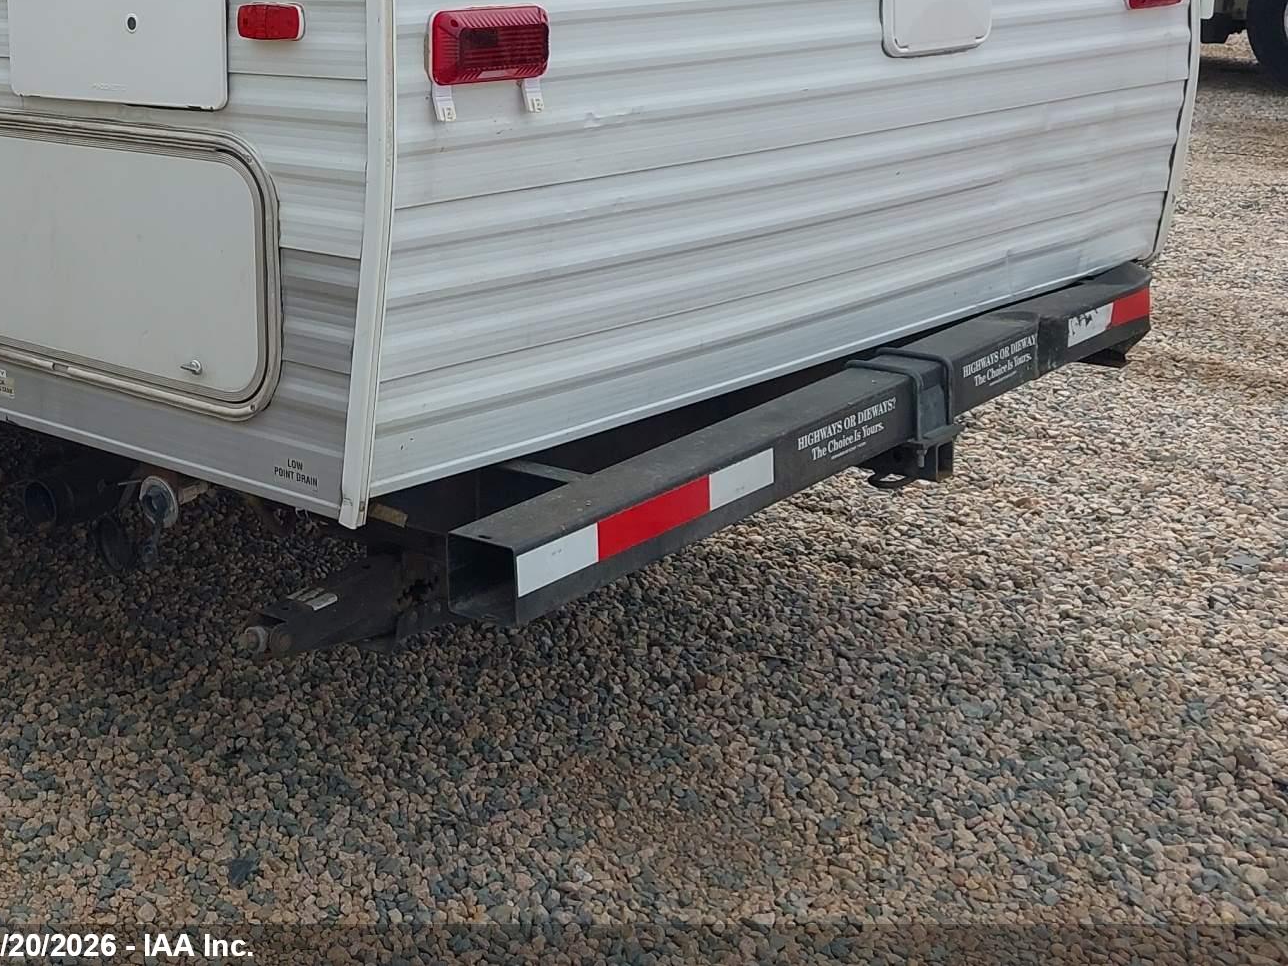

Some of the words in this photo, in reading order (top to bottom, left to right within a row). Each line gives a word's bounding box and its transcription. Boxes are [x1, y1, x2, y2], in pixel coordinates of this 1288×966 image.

[962, 351, 999, 378] HIGHWAYS
[999, 346, 1010, 360] OR
[974, 375, 987, 387] The
[986, 364, 1008, 381] Choice
[1007, 359, 1014, 371] Is
[797, 420, 843, 451] HIGHWAYS
[843, 414, 857, 430] OR
[857, 396, 897, 424] DIEWAYS?
[811, 446, 827, 461] The
[827, 435, 853, 453] Choice
[853, 429, 862, 442] Is
[861, 422, 885, 439] Yours.
[274, 466, 294, 480] POINT
[296, 472, 318, 487] DRAIN
[287, 458, 303, 471] LOW
